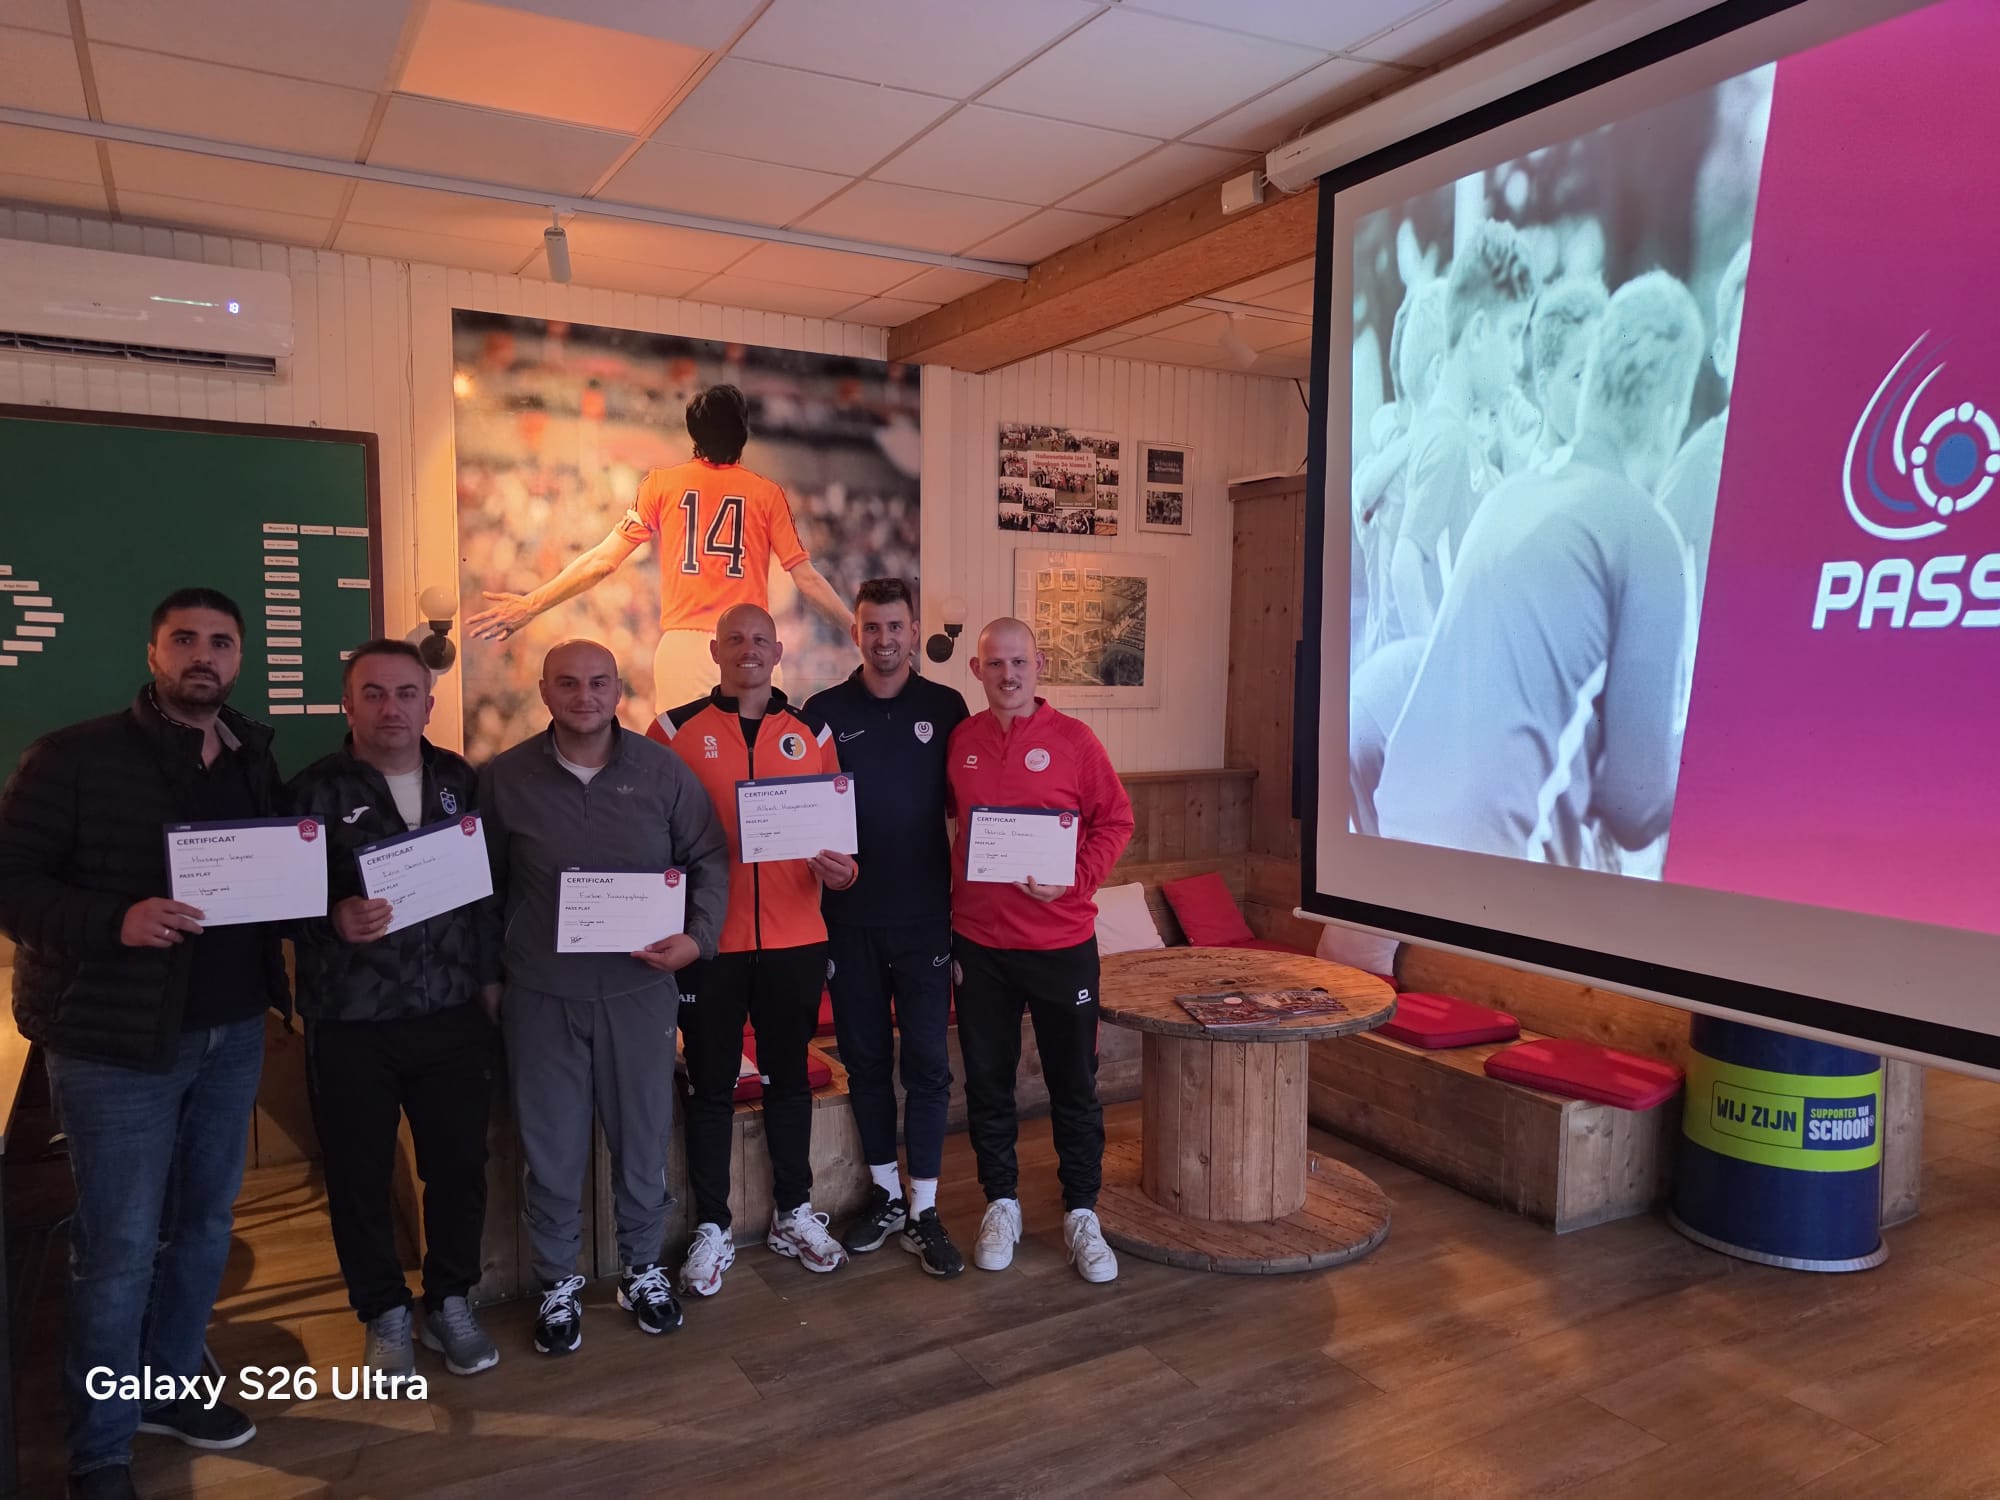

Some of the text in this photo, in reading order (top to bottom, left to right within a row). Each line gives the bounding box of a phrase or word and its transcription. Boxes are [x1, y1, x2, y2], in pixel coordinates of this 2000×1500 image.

[679, 489, 746, 579] 14
[1811, 553, 2000, 630] PASS
[704, 750, 718, 759] AH
[744, 789, 788, 798] CERTIFICAAT
[176, 835, 237, 846] CERTIFICAAT
[366, 845, 415, 866] CERTIFICAAT
[1716, 1096, 1797, 1132] WIJ ZIJN
[1810, 1105, 1869, 1118] SUPPORTER VAN
